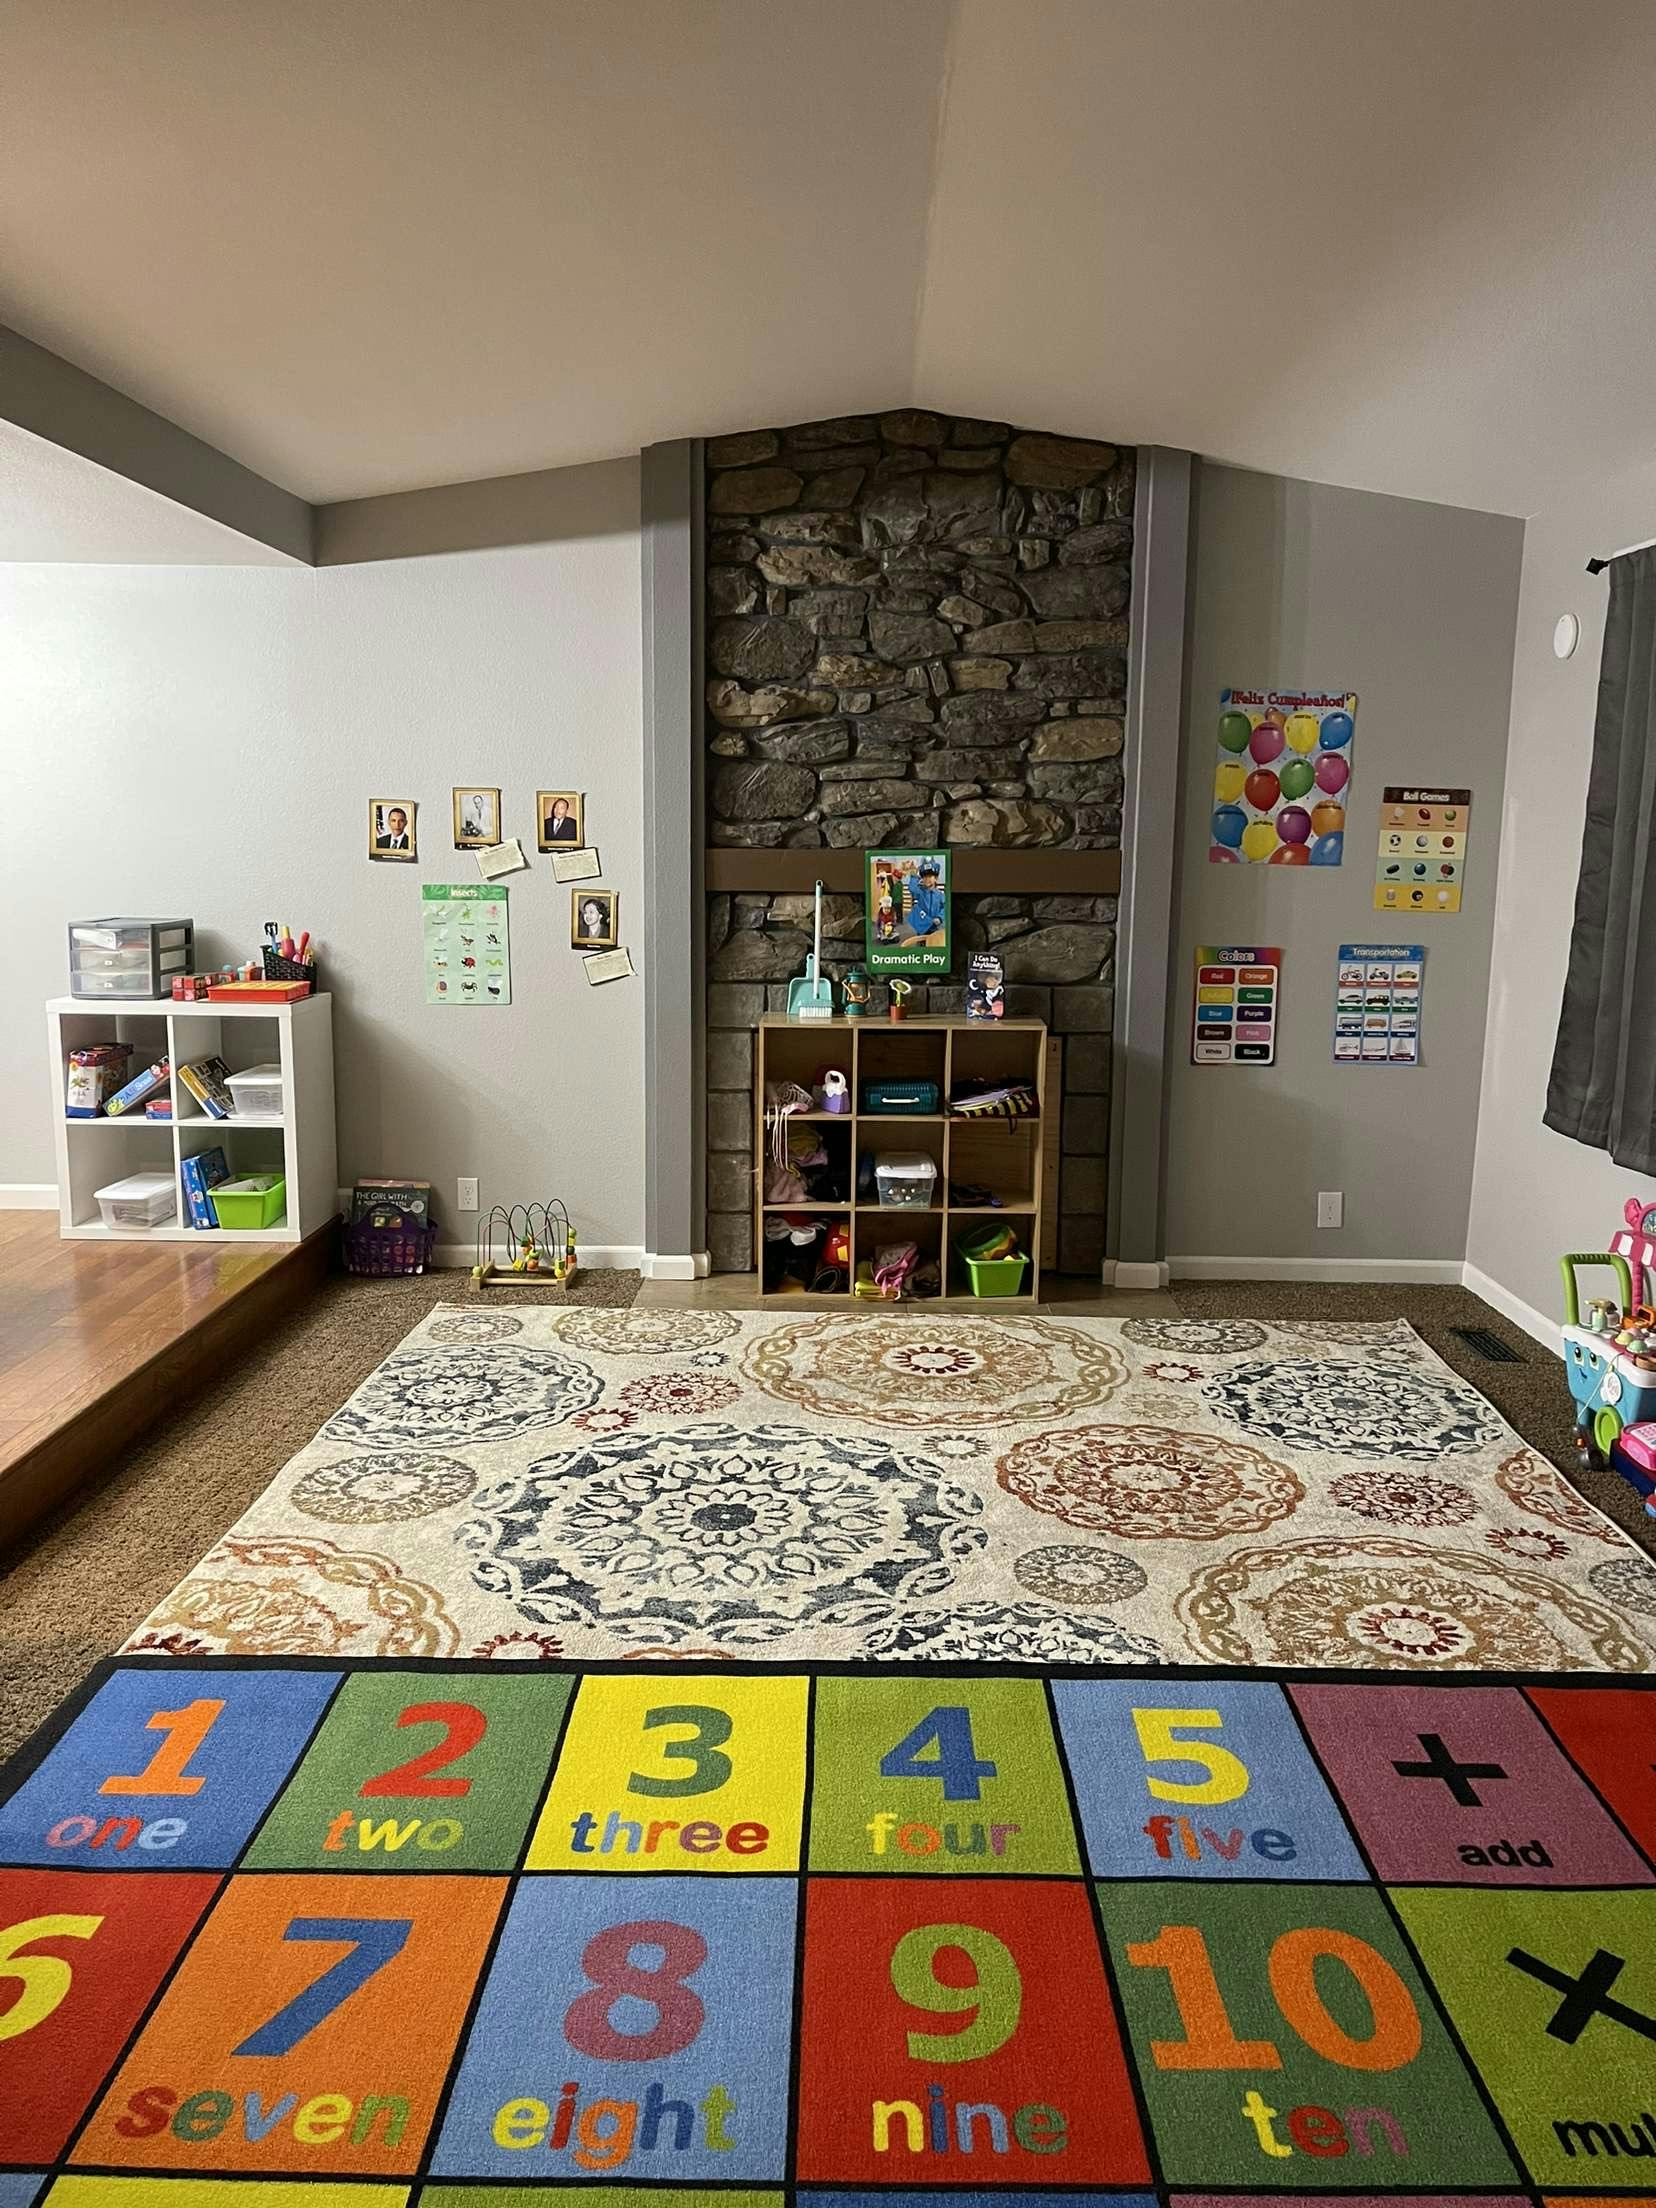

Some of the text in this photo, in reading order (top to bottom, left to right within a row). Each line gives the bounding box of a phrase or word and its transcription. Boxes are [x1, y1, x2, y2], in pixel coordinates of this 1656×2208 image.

[1402, 791, 1450, 802] Ball Games
[871, 954, 946, 966] Dramatic Play
[1218, 950, 1255, 962] Colors
[1353, 948, 1410, 957] Transportation
[355, 1192, 408, 1201] THE GIRL WITH
[97, 1698, 227, 1796] 1
[357, 1701, 488, 1797] 2
[626, 1705, 733, 1798] 3
[879, 1706, 997, 1800] 4
[1130, 1707, 1250, 1805] 5
[46, 1815, 188, 1849] one
[321, 1811, 465, 1851] two
[569, 1812, 770, 1855] three
[867, 1813, 1021, 1856] four
[1142, 1815, 1297, 1861] five
[1459, 1838, 1555, 1868] add
[0, 1914, 106, 2042] 6
[231, 1917, 415, 2057] 7
[563, 1920, 709, 2063] 8
[890, 1923, 1023, 2064] 9
[1124, 1925, 1422, 2072] 10
[113, 2086, 412, 2147] seven
[491, 2081, 738, 2169] eight
[872, 2084, 1069, 2154] nine
[1241, 2090, 1410, 2158] ten
